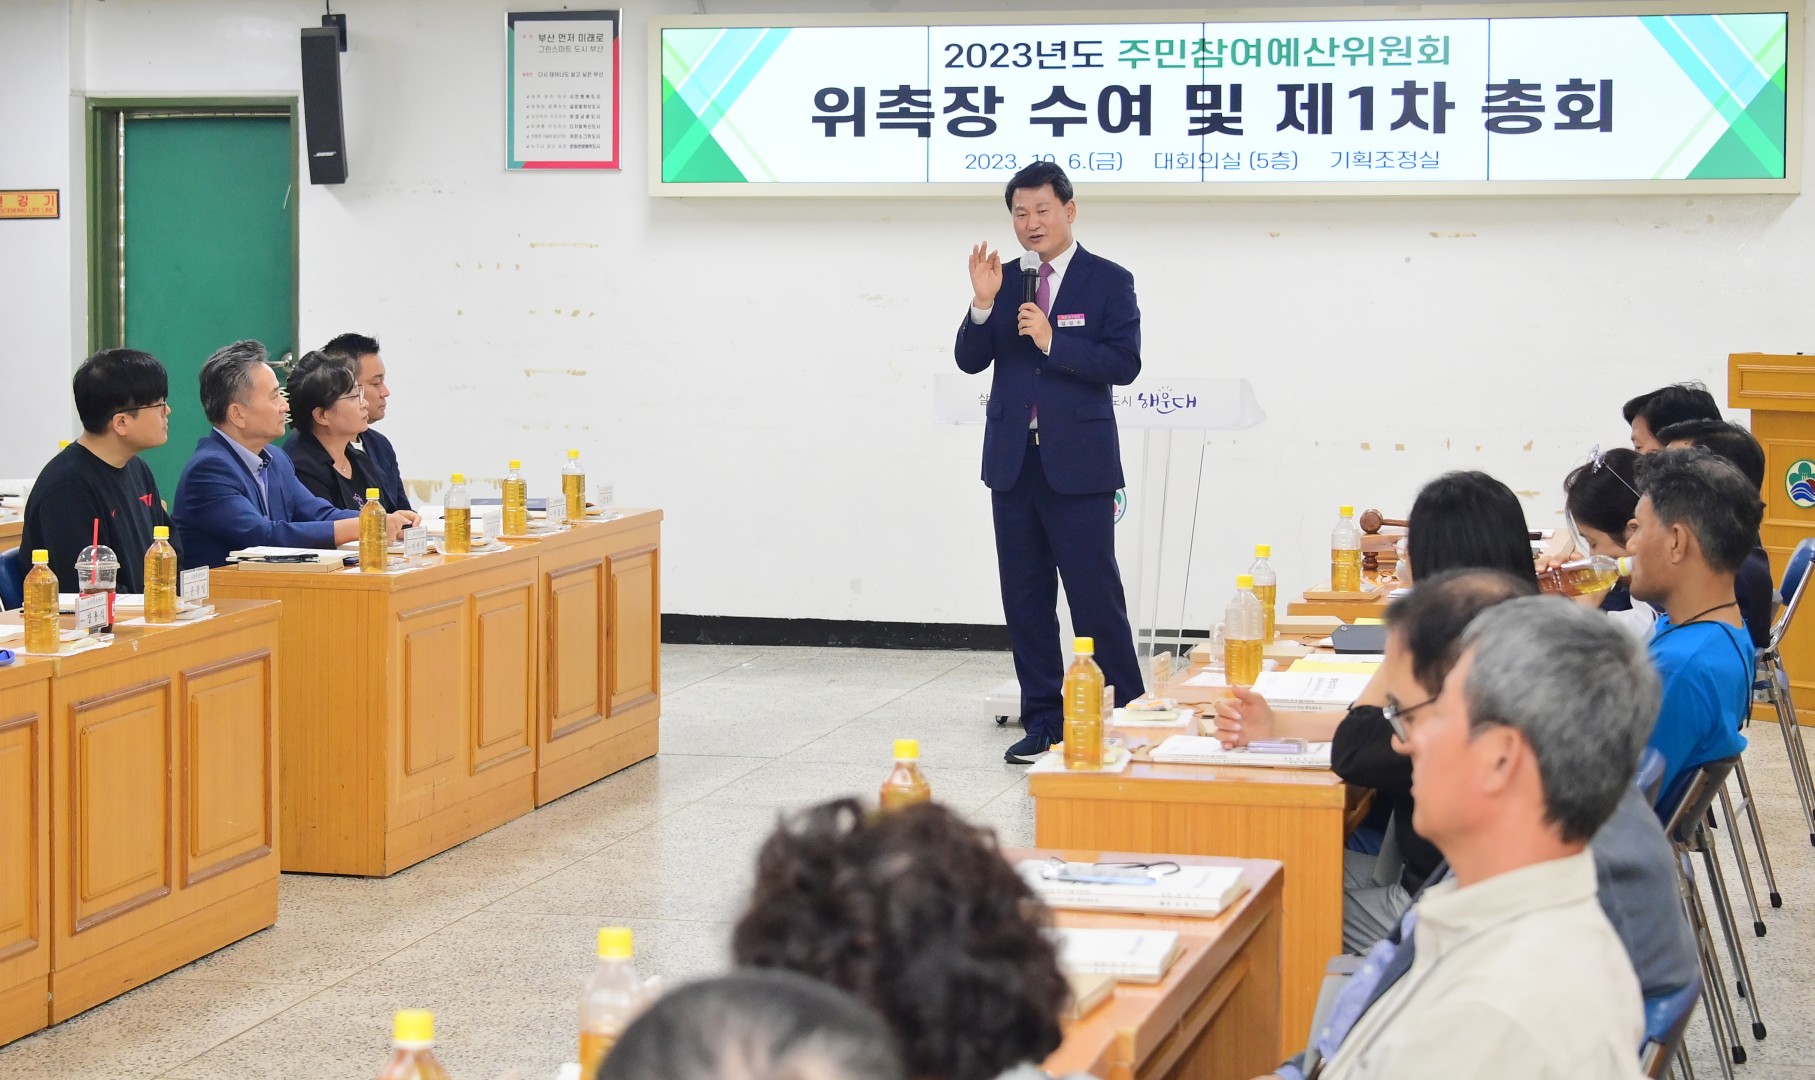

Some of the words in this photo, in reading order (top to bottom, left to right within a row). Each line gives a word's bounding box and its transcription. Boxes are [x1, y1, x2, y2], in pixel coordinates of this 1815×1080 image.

[538, 33, 555, 43] 부산
[558, 33, 575, 43] 먼저
[578, 33, 604, 43] 미래로
[538, 45, 571, 53] 그린스마트
[574, 45, 588, 53] 도시
[590, 45, 604, 53] 부산
[943, 40, 1105, 70] 2023년도
[1117, 34, 1450, 70] 주민참여예산위원회
[811, 84, 1005, 139] 위촉장
[1029, 83, 1152, 138] 수여
[1186, 83, 1244, 136] 및
[1275, 80, 1456, 135] 제1차
[1481, 77, 1614, 135] 총회
[965, 153, 1022, 170] 2023.
[1068, 151, 1123, 171] 6.(금)
[1154, 151, 1241, 170] 대회의실
[1249, 150, 1298, 170] (5층)
[1330, 150, 1440, 169] 기획조정실
[1138, 392, 1196, 414] 해운대
